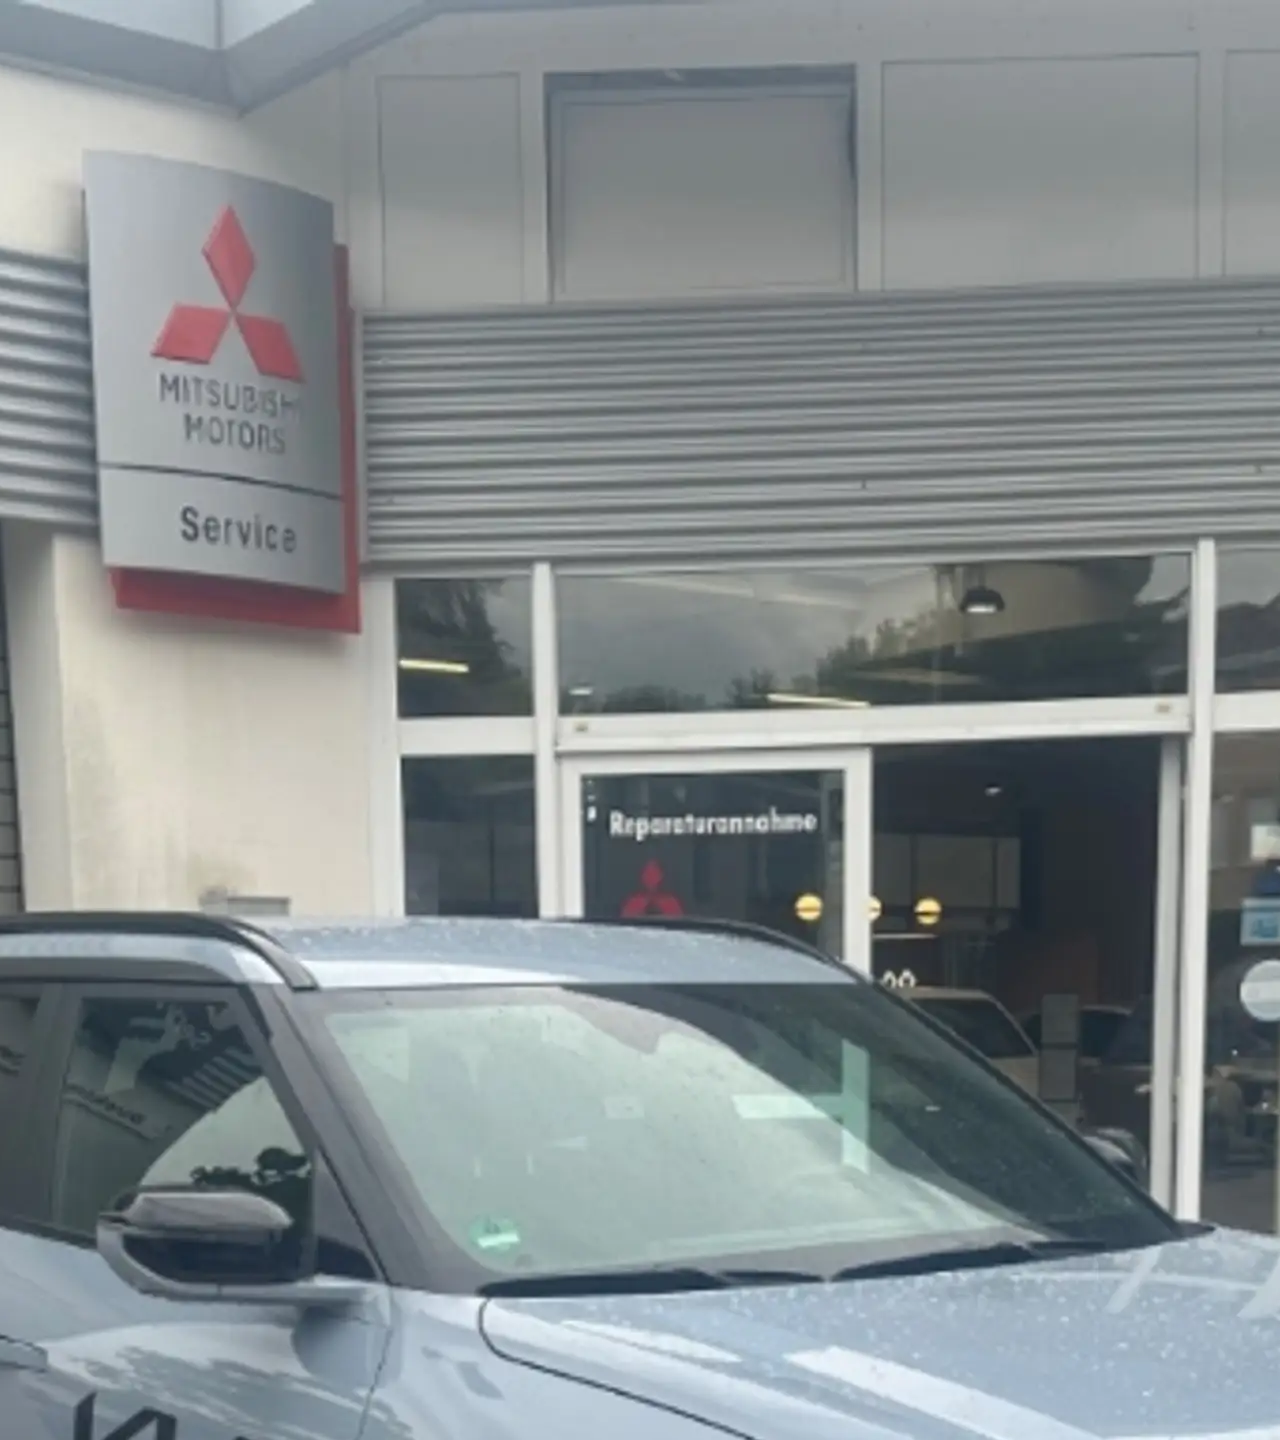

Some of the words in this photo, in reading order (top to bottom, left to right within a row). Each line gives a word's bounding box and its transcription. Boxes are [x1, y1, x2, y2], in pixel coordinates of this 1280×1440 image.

[159, 372, 304, 420] MITSUBISH
[184, 412, 286, 456] MOTORS
[180, 504, 298, 554] Service
[610, 806, 818, 842] Reparaturannahme
